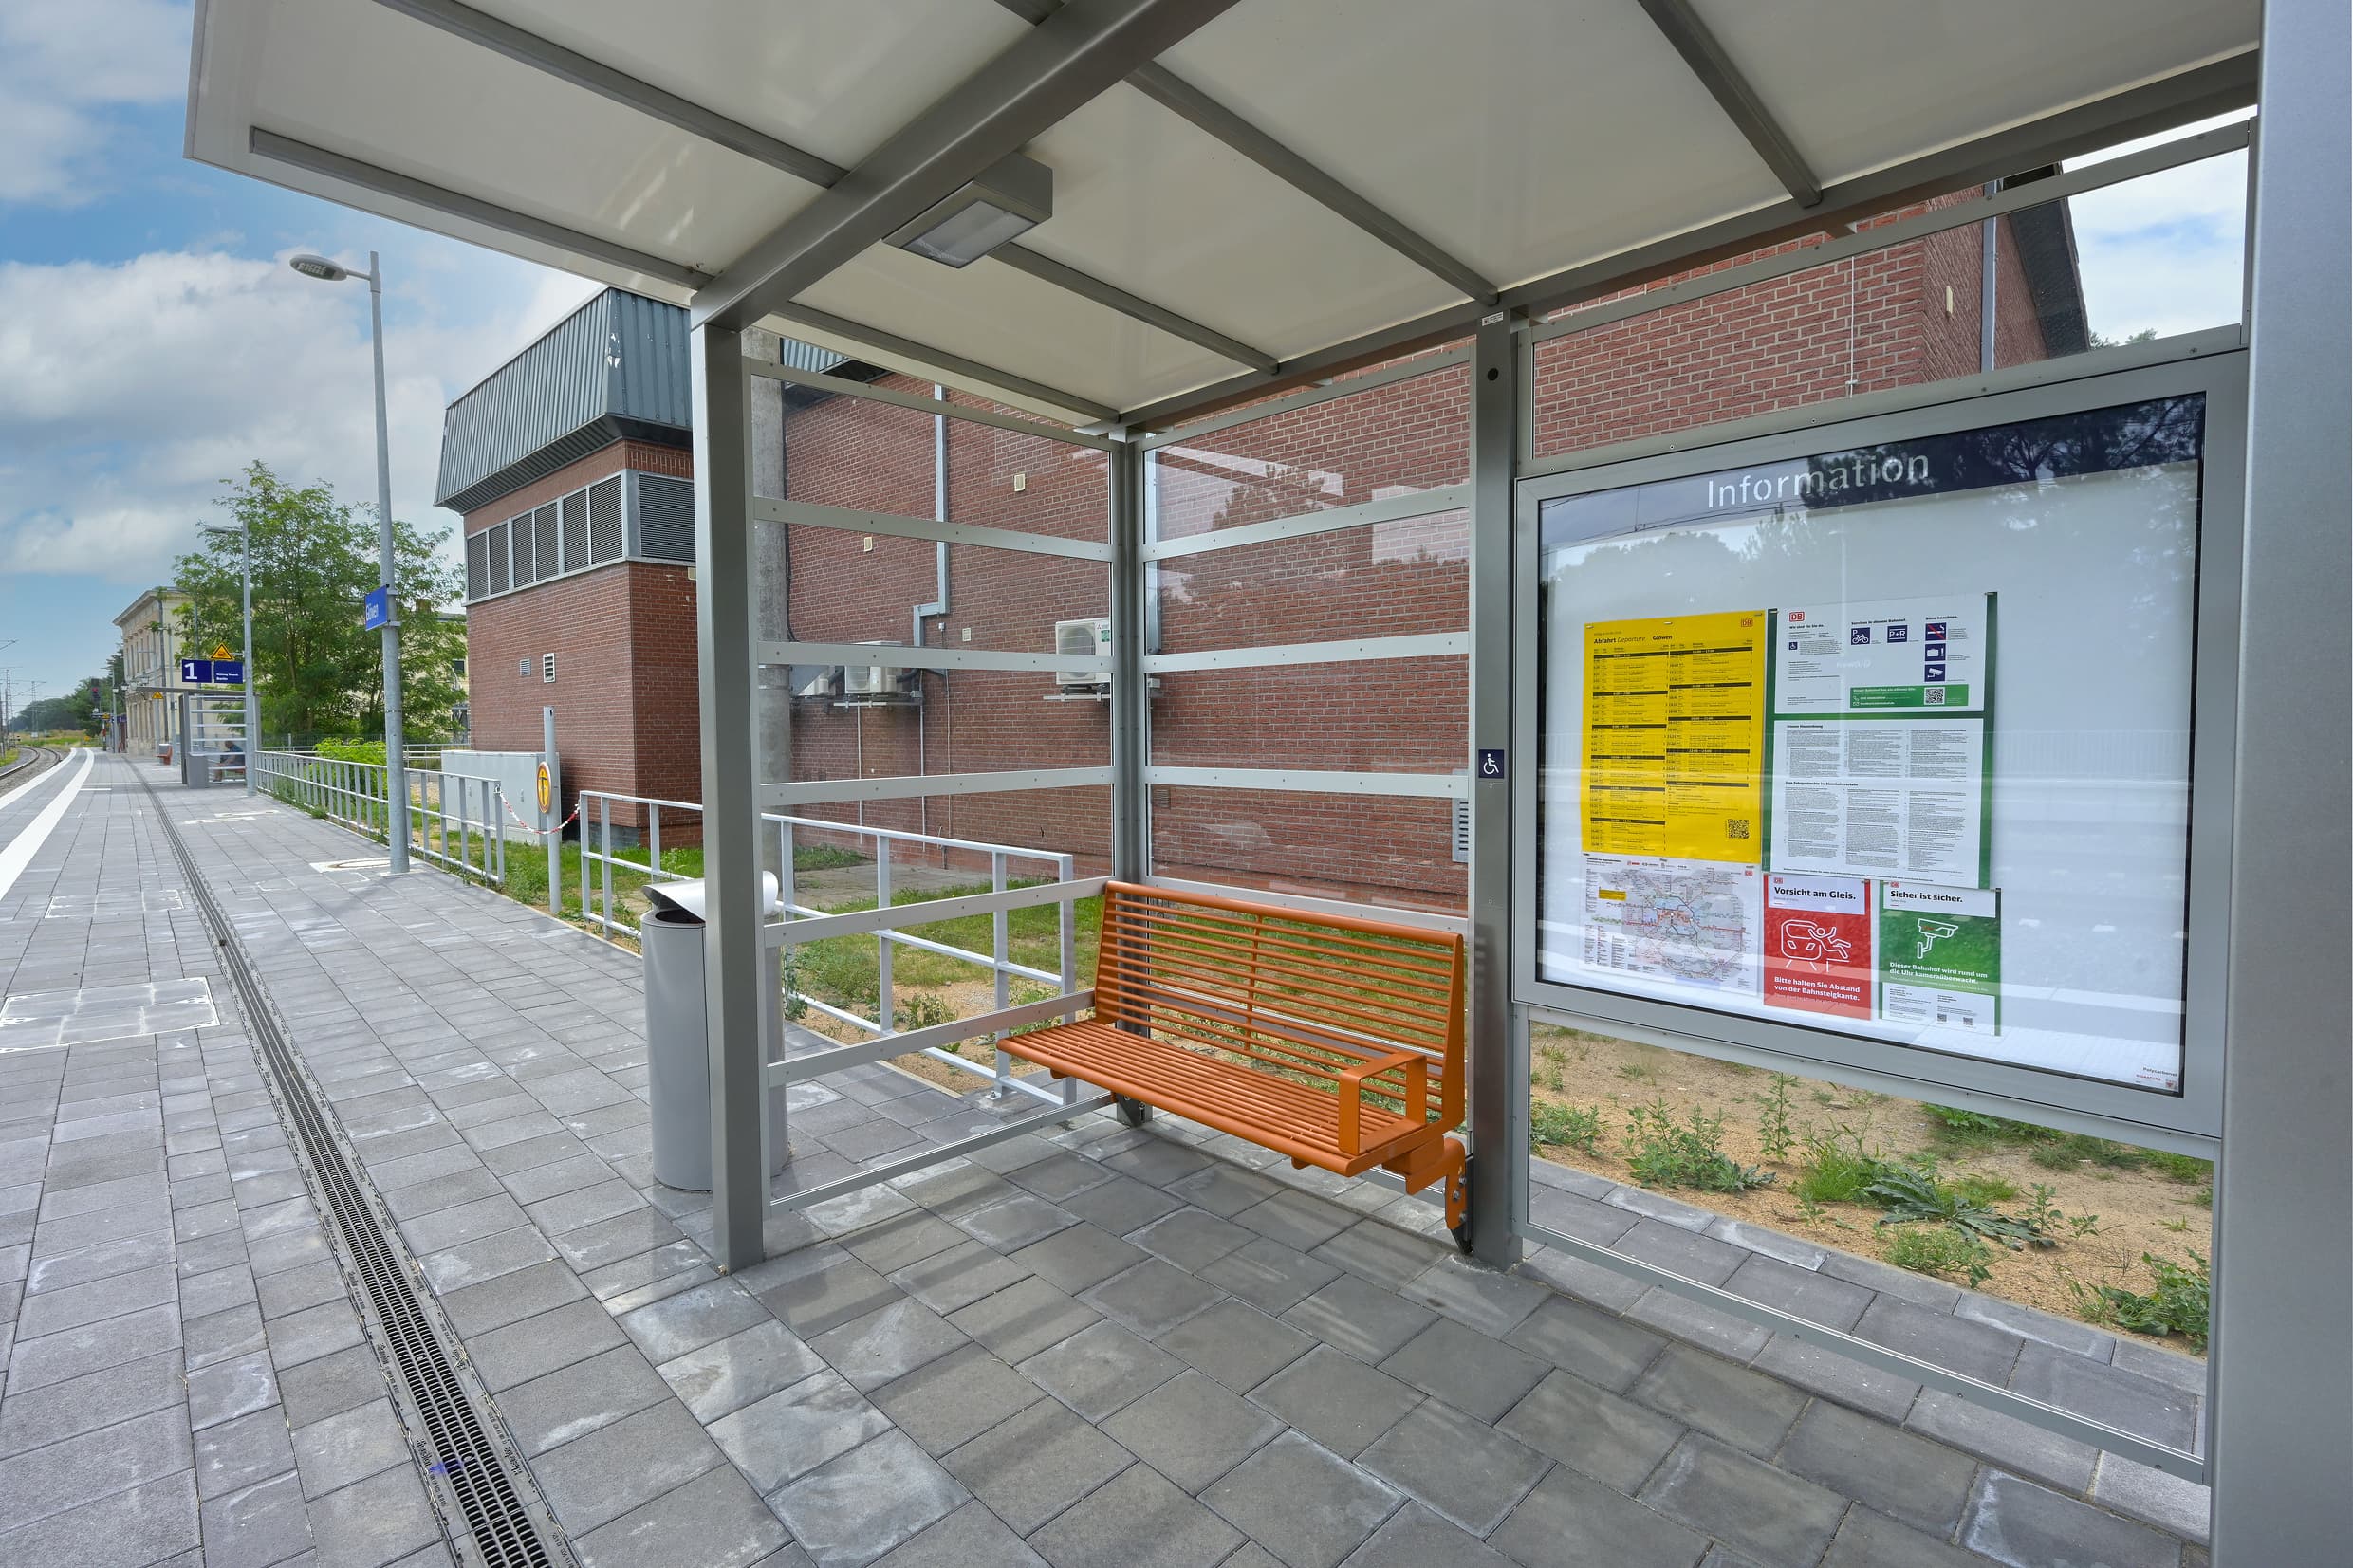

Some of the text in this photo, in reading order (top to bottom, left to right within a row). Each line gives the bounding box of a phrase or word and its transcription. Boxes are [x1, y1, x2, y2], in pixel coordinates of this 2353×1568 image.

[1708, 454, 1929, 508] Information
[1790, 613, 1804, 621] DB
[184, 663, 198, 680] 1
[1774, 887, 1811, 896] Vorsicht
[1829, 891, 1856, 900] Gleis.
[1890, 890, 1918, 899] Sicher
[1933, 894, 1963, 902] sicher.
[1912, 964, 1940, 972] Bahnhof
[1915, 971, 1979, 984] kameraüberwacht.
[1793, 979, 1815, 987] halten
[1829, 983, 1860, 993] Abstand
[1802, 988, 1860, 1001] Bahnsteigkante.
